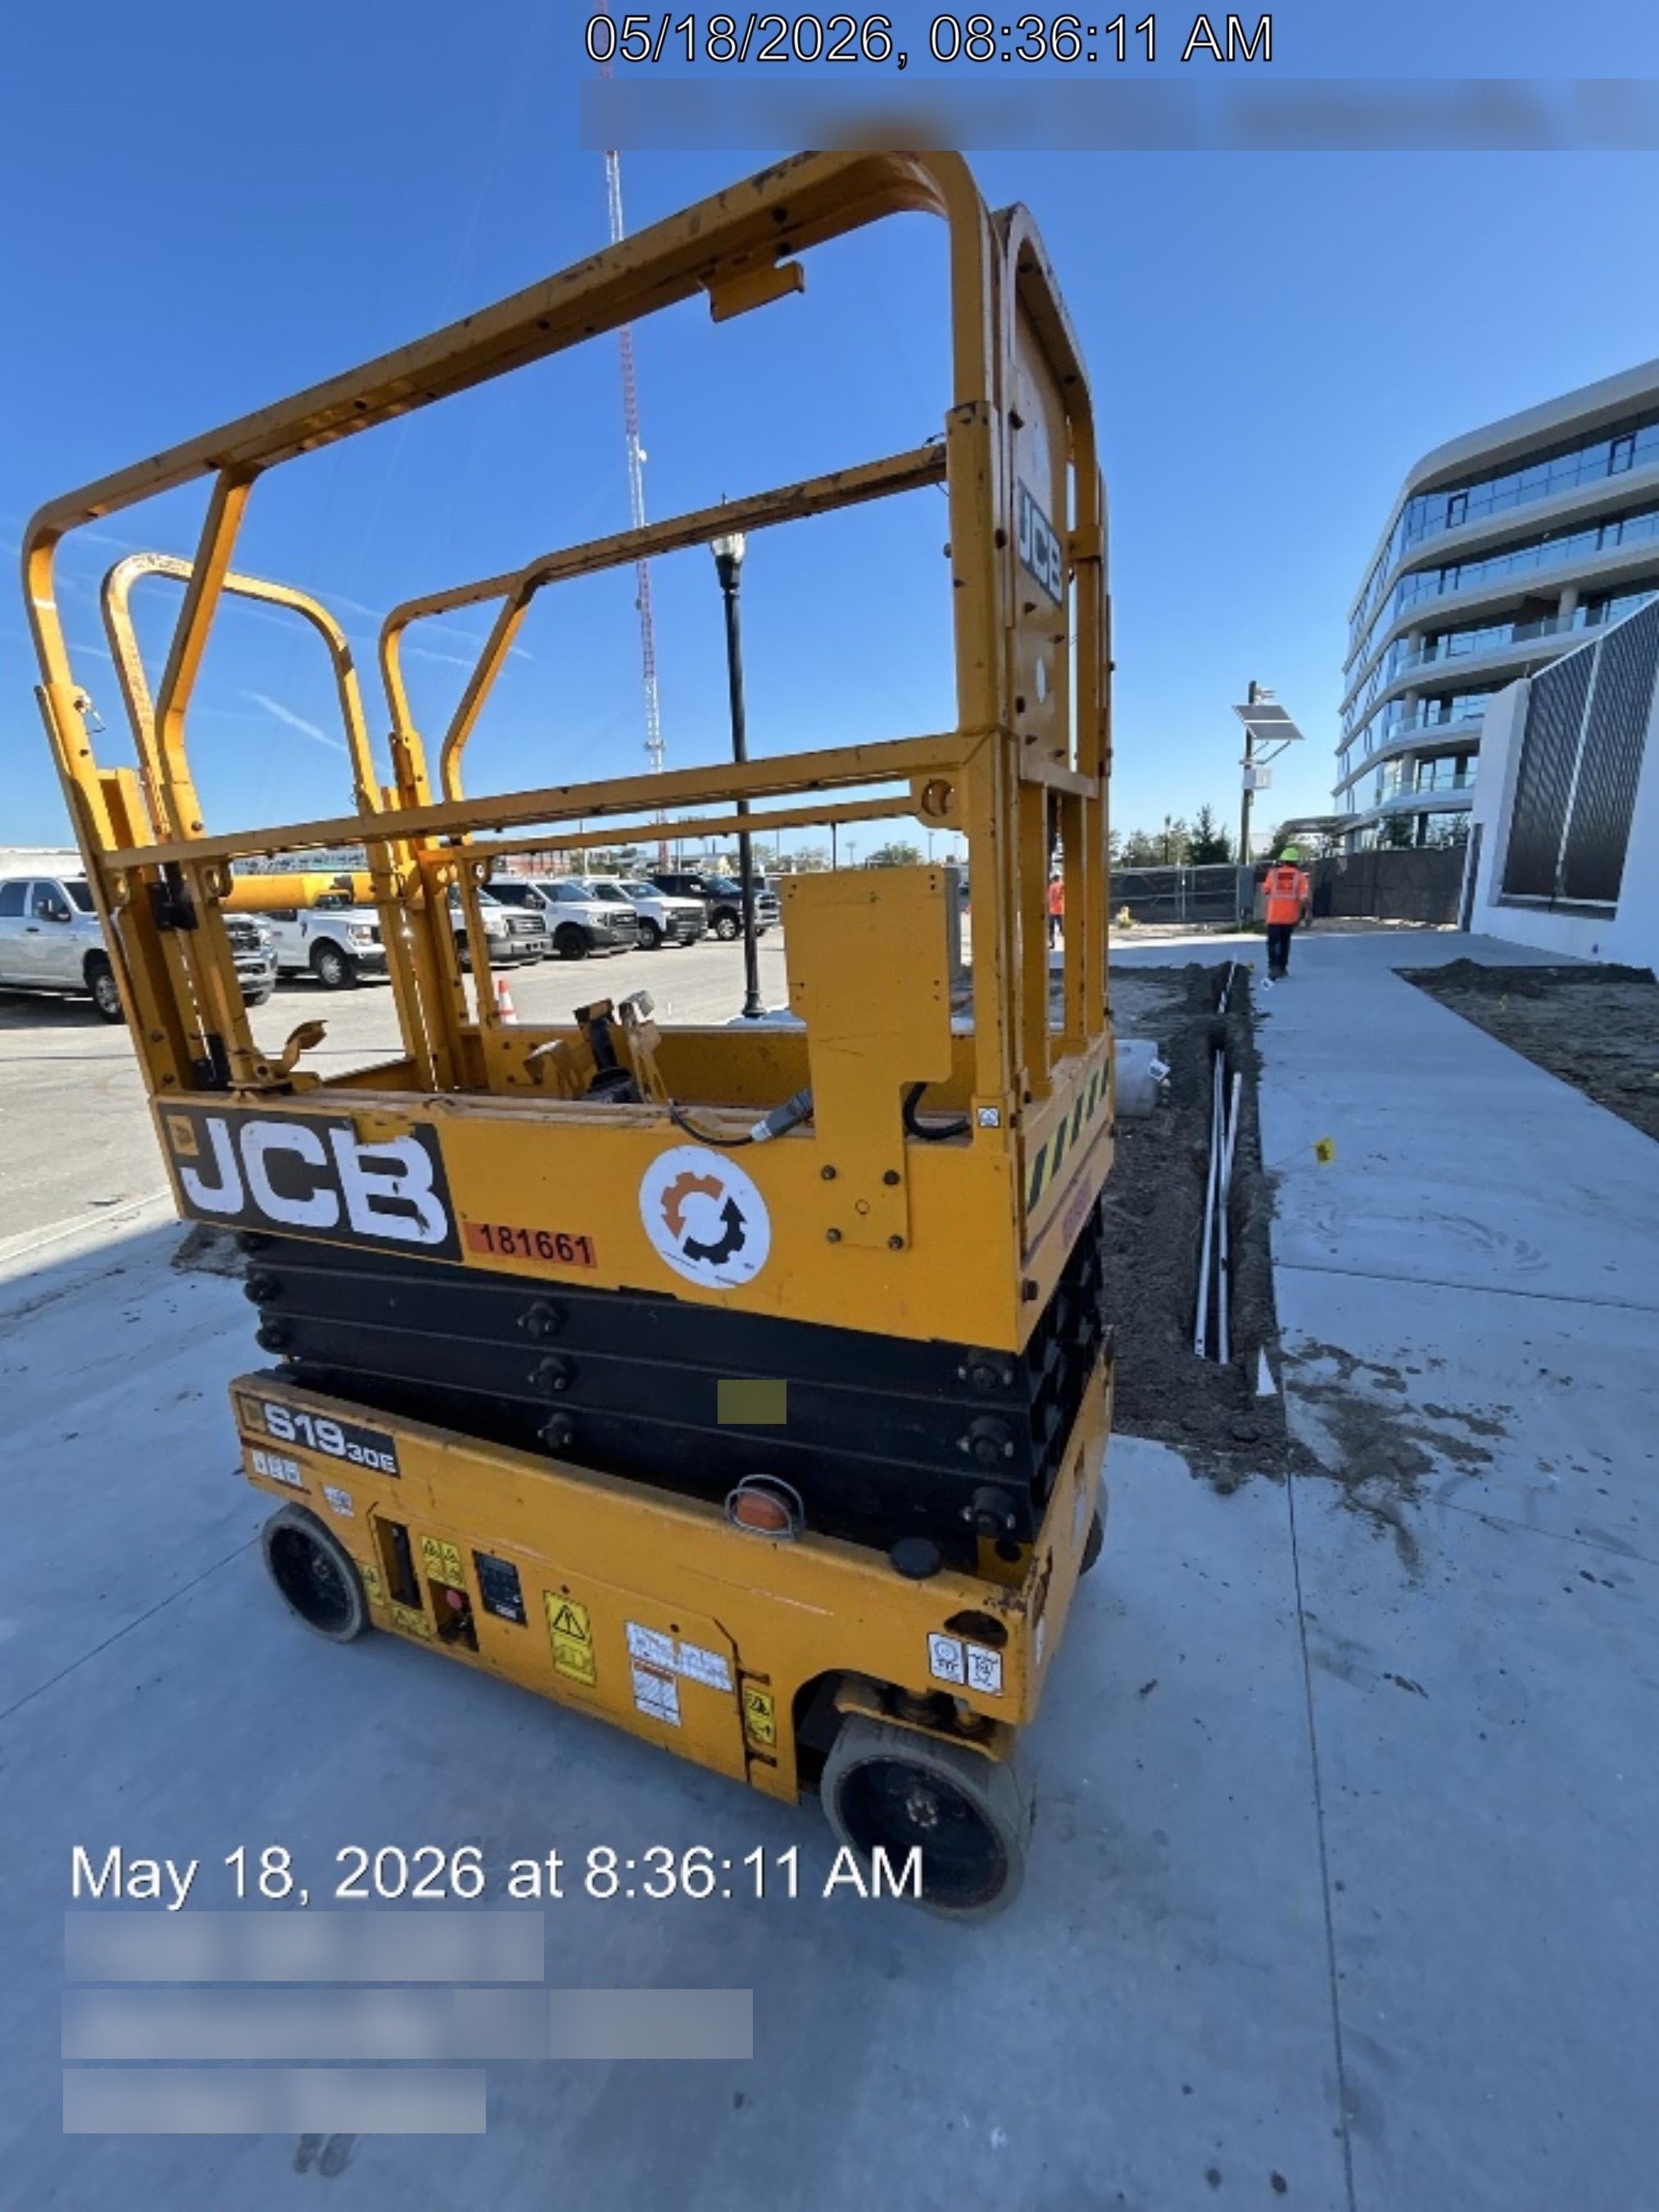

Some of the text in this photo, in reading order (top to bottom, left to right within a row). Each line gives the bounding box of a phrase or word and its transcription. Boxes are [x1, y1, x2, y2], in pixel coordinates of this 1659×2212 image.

[1019, 493, 1063, 604] JCB
[179, 1117, 448, 1244] JCB
[481, 1224, 591, 1264] 181661
